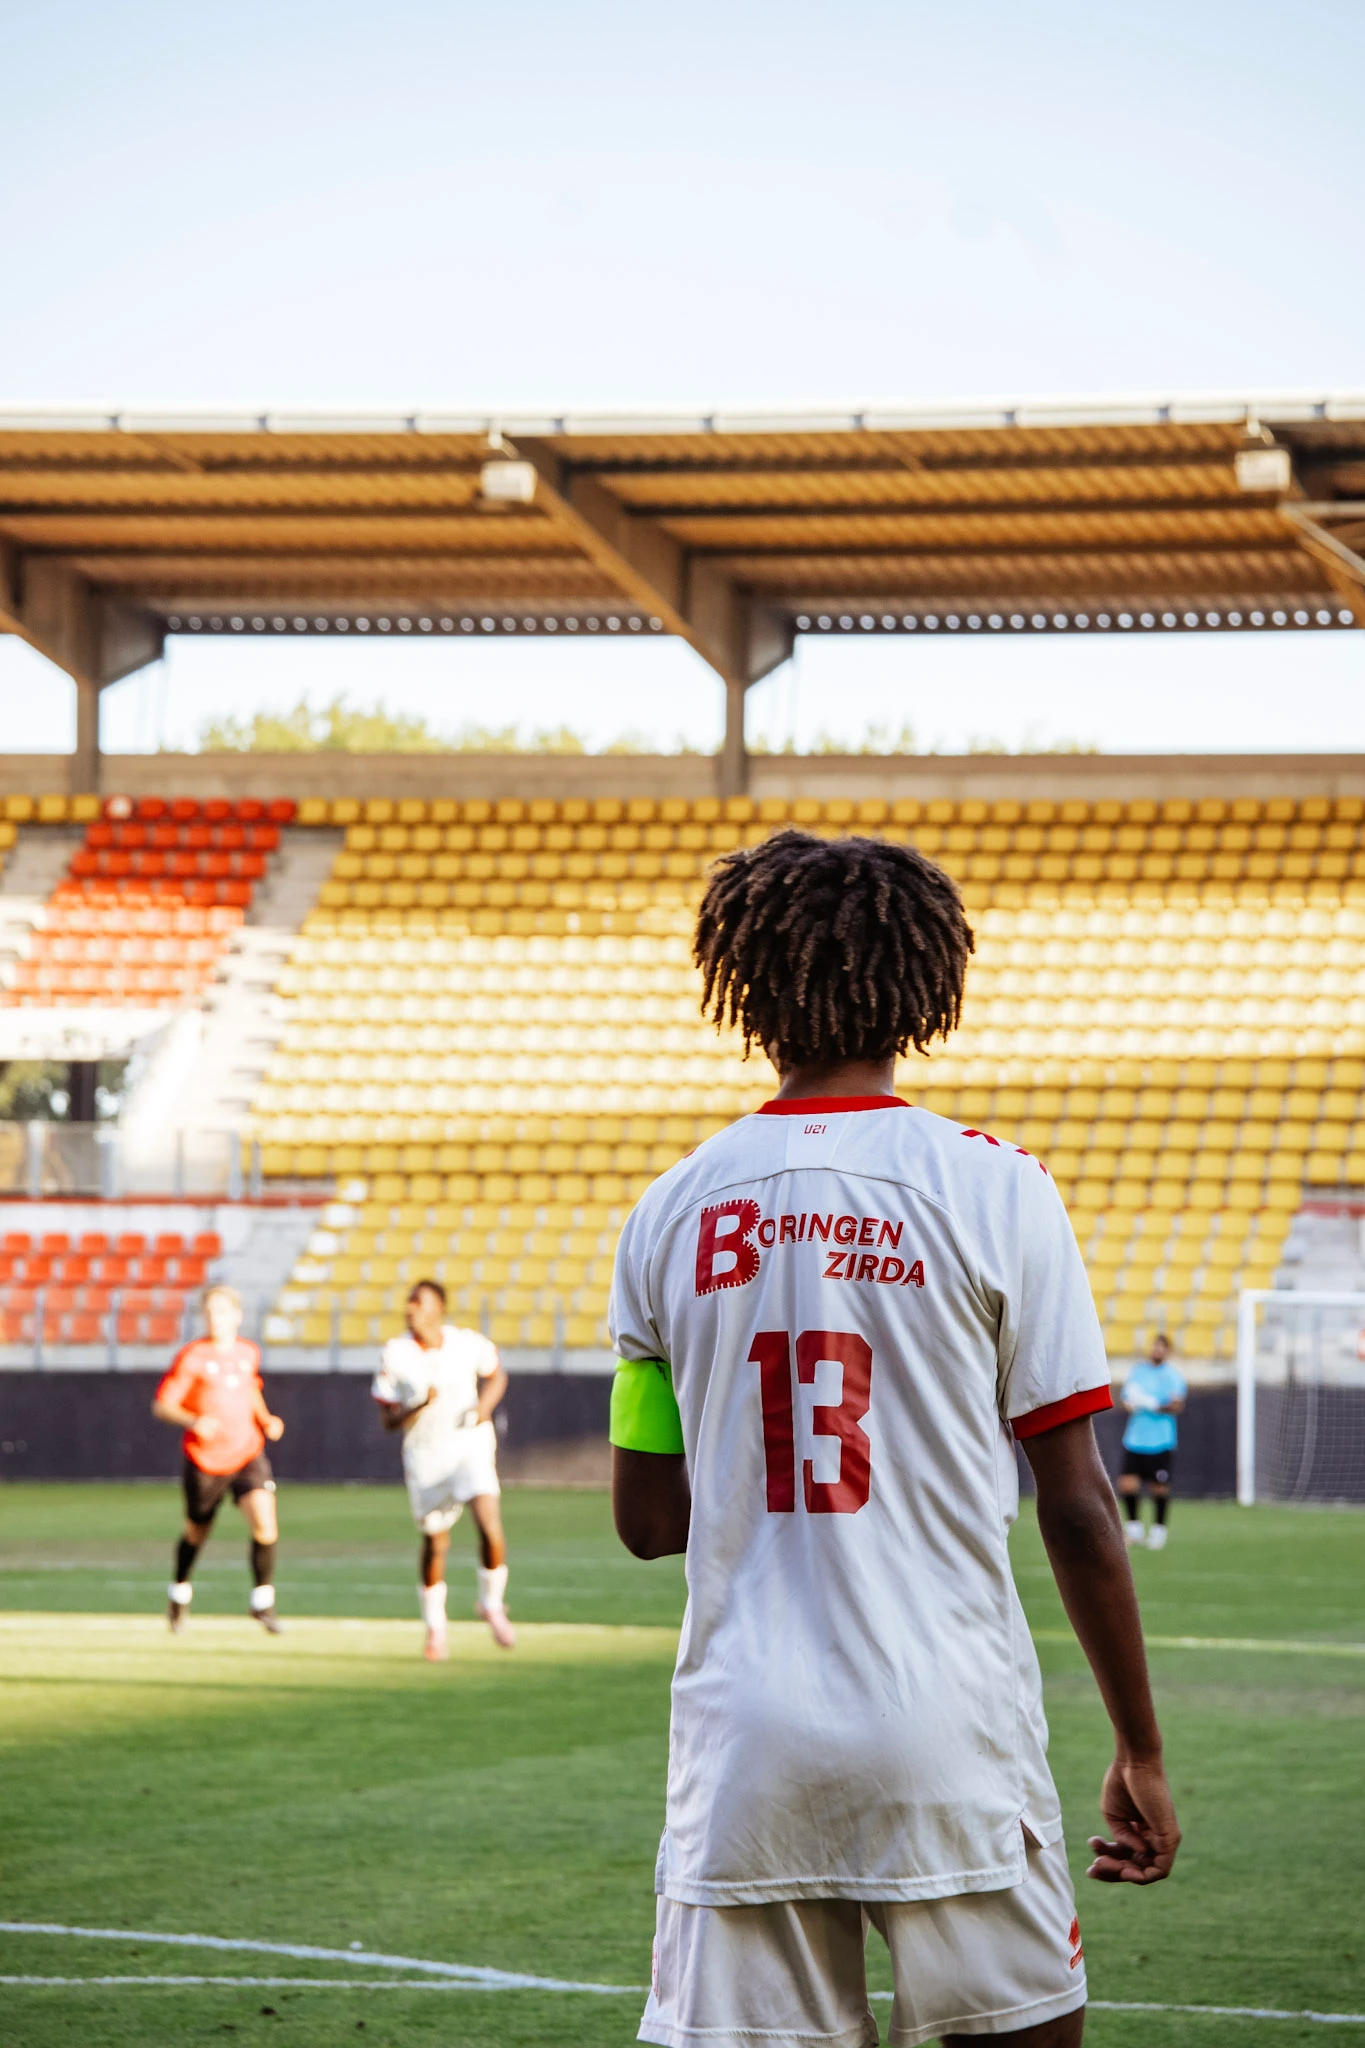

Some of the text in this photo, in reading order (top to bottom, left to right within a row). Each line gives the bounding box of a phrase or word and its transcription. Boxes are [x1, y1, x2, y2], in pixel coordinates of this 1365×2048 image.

[804, 1124, 827, 1135] U21
[695, 1198, 904, 1298] BORINGEN
[822, 1251, 925, 1288] ZIRDA
[747, 1330, 873, 1515] 13
